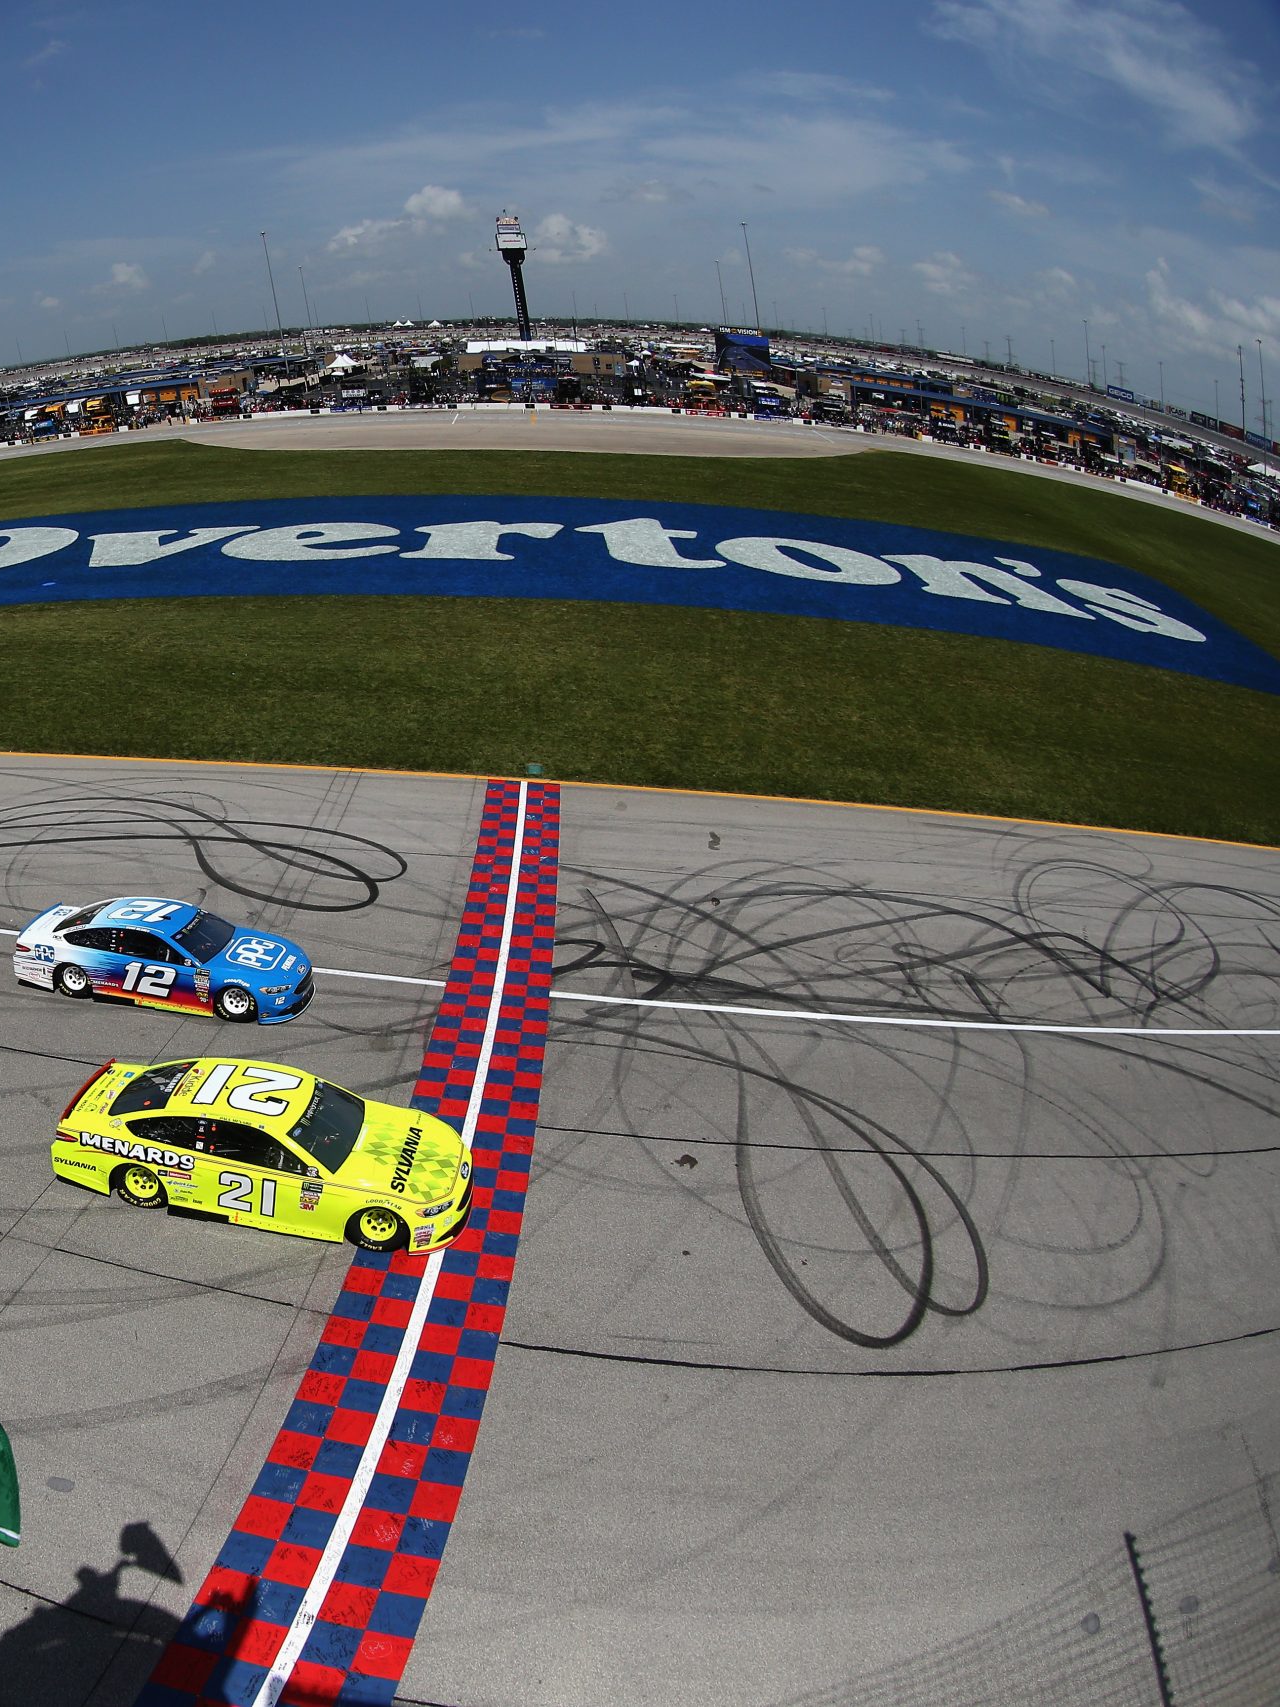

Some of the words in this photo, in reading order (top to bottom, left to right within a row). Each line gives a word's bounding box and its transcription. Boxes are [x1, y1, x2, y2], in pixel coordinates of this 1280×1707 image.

[736, 328, 758, 336] VISION
[1108, 388, 1133, 399] GEICO
[107, 900, 183, 923] 12
[35, 945, 55, 961] PPG
[235, 937, 276, 968] PPG
[92, 980, 119, 988] MENARDS
[122, 961, 177, 998] 12
[274, 996, 286, 1005] 12
[191, 1064, 304, 1117] 21
[80, 1132, 196, 1171] MENARDS
[390, 1126, 423, 1194] SYLVANIA
[54, 1157, 97, 1172] SYLVANIA
[218, 1170, 278, 1218] 21
[299, 1202, 315, 1212] 3M
